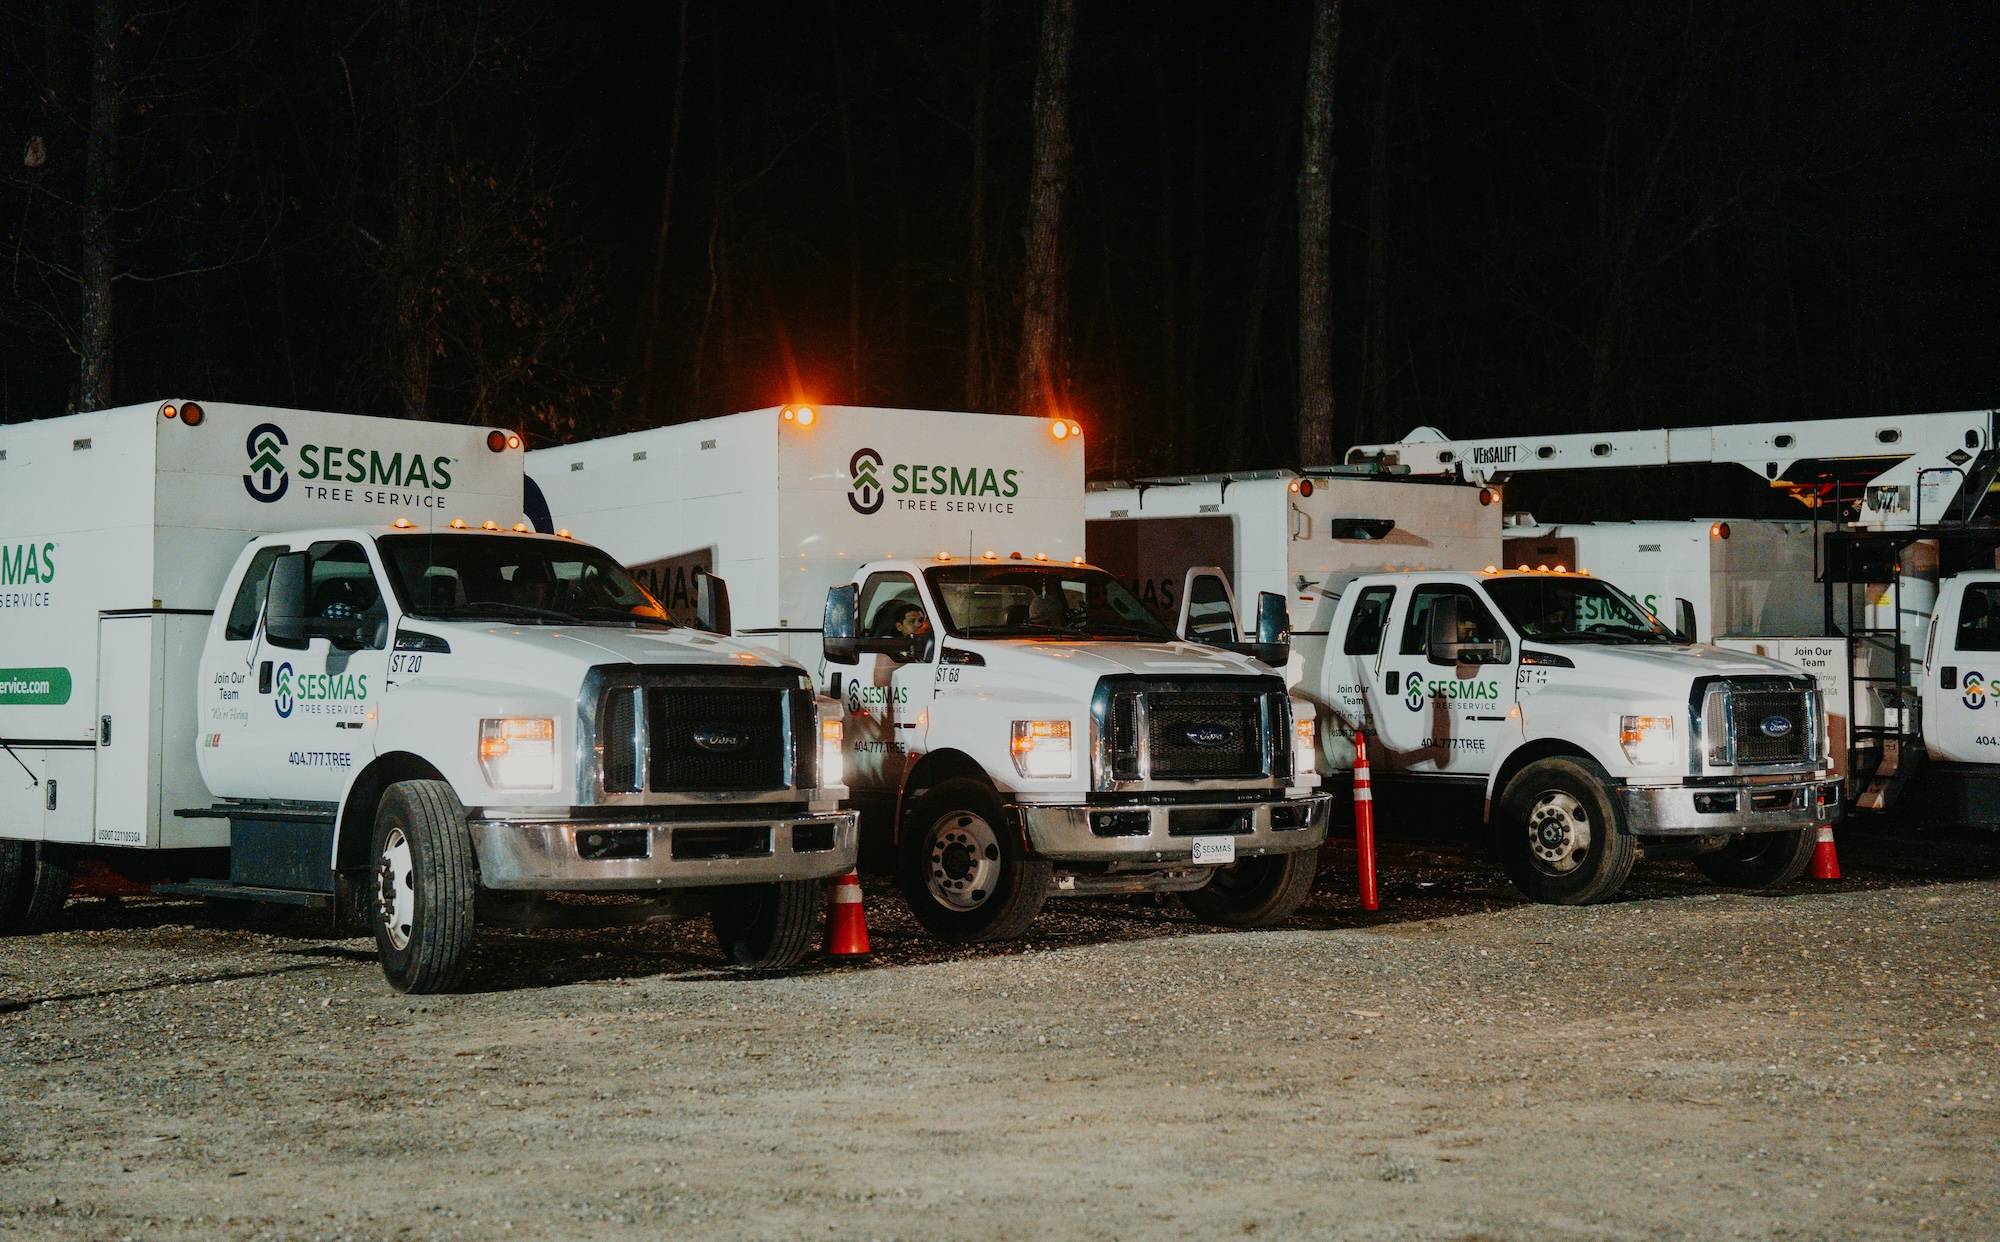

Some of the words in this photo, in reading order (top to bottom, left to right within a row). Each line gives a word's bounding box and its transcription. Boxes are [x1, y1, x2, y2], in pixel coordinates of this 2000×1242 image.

[1473, 445, 1517, 464] VERSALIFT
[298, 444, 452, 490] SESMAS
[891, 464, 1019, 498] SESMAS
[304, 486, 353, 502] TREE
[364, 491, 446, 509] SERVICE
[897, 499, 937, 511] TREE
[946, 501, 1014, 514] SERVICE
[1794, 646, 1813, 656] Join
[1815, 647, 1832, 656] Our
[392, 655, 407, 673] ST
[407, 655, 422, 673] 20
[1801, 658, 1826, 667] Team
[214, 671, 229, 685] Join
[231, 671, 246, 685] Our
[936, 667, 948, 682] ST
[949, 668, 960, 682] 68
[1519, 669, 1532, 683] ST
[219, 688, 239, 700] Team
[297, 674, 368, 701] SESMAS
[1337, 684, 1353, 694] Join
[1354, 684, 1369, 694] Our
[1427, 680, 1498, 700] SESMAS
[862, 686, 908, 704] SESMAS
[1343, 695, 1364, 705] Team
[300, 704, 322, 714] TREE
[326, 704, 365, 715] SERVICE
[1431, 701, 1453, 710] TREE
[1457, 702, 1496, 710] SERVICE
[1976, 736, 2000, 746] 404.
[288, 751, 351, 767] 404.777.TREE
[1202, 844, 1232, 854] SESMAS
